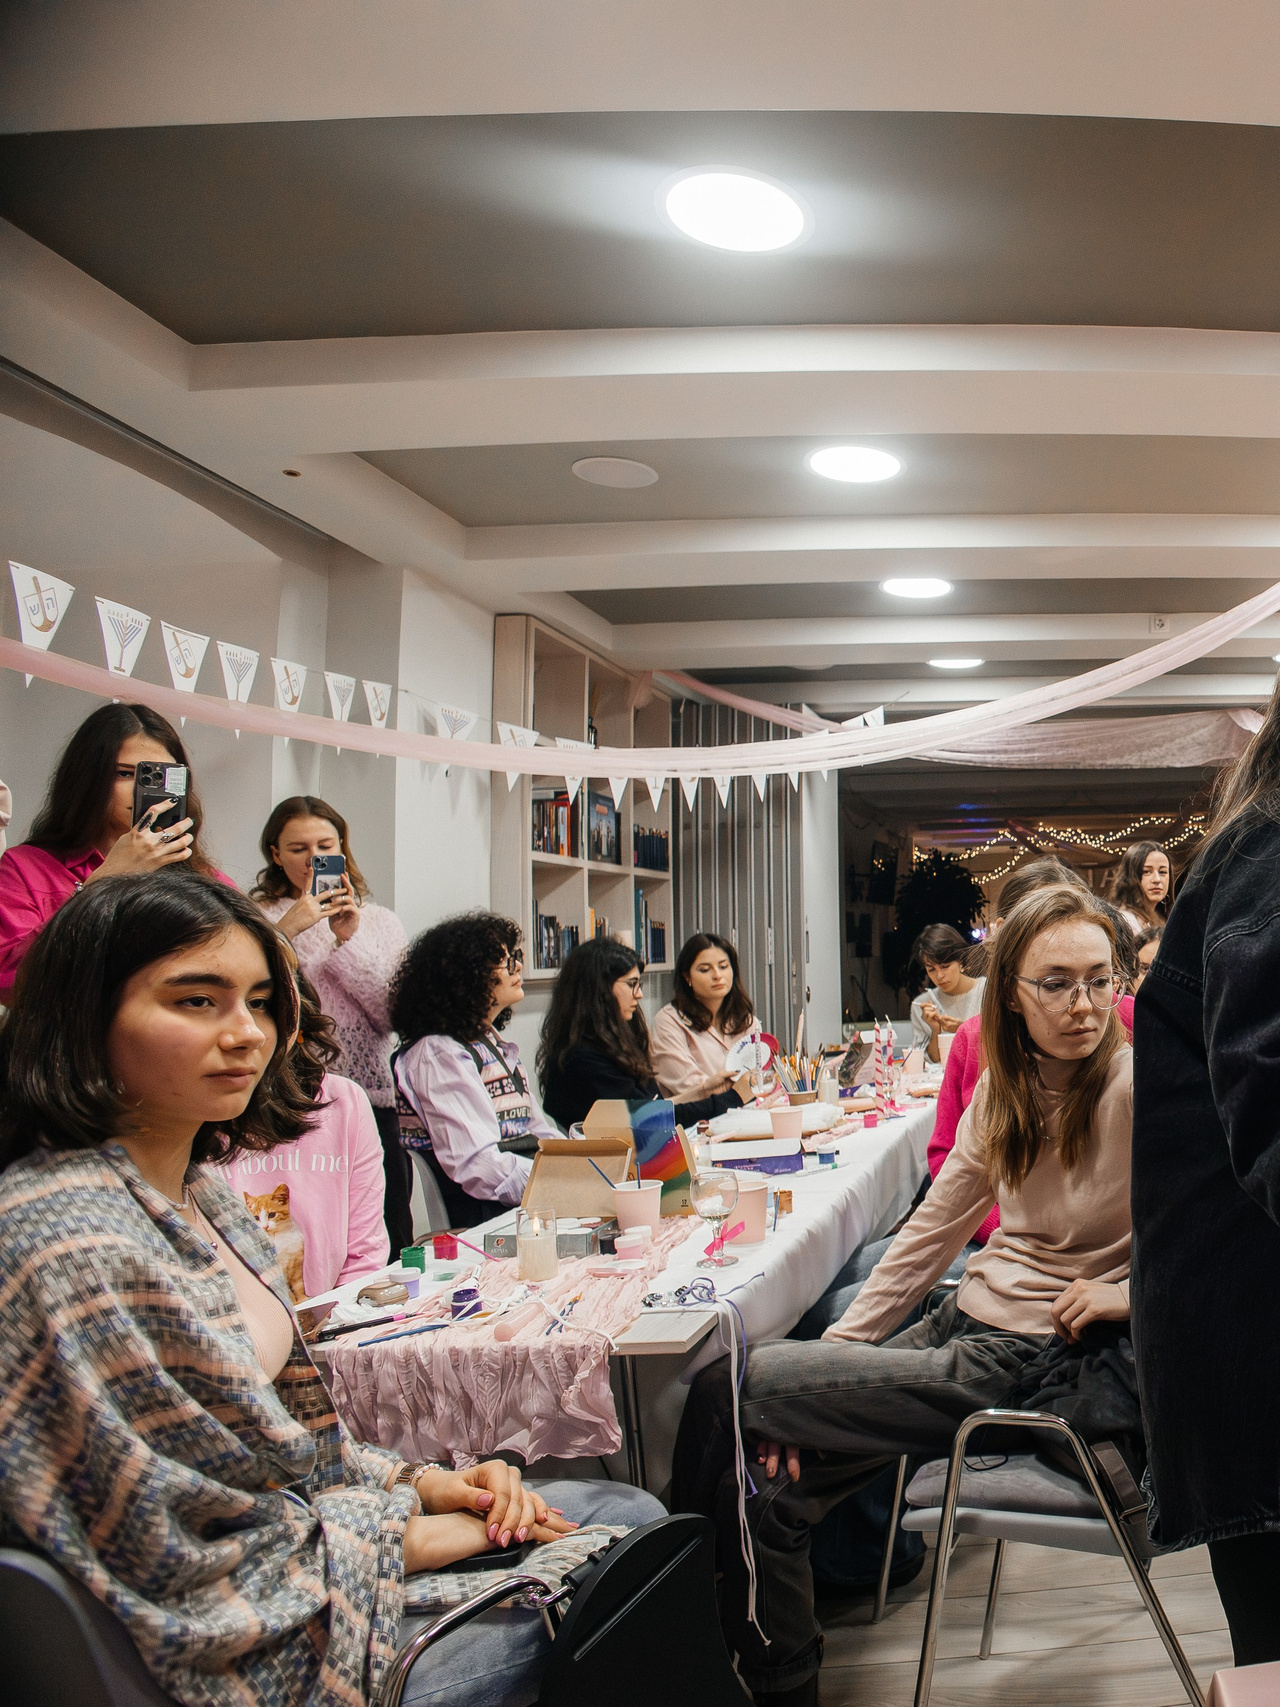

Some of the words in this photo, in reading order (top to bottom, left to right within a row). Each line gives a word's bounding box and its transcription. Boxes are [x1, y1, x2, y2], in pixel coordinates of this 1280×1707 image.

[29, 603, 40, 616] ש
[504, 1106, 527, 1120] LOVE
[311, 1152, 348, 1173] me
